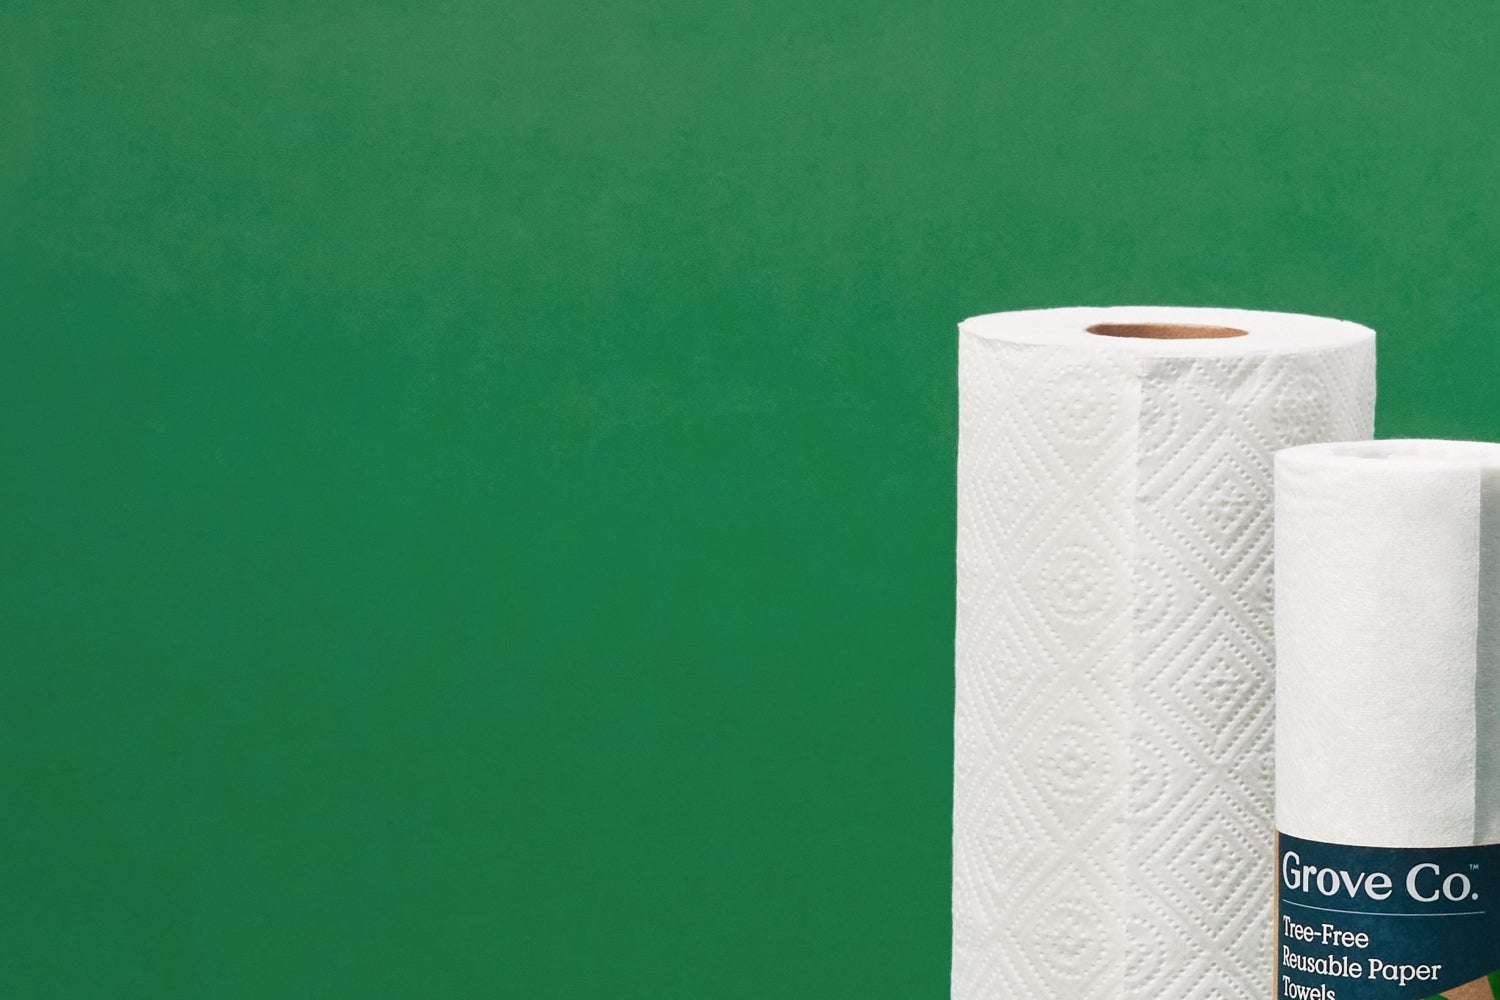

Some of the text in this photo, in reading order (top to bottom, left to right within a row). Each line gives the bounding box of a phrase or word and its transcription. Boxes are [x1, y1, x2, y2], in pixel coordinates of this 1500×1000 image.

[1283, 851, 1392, 900] Grove
[1283, 915, 1369, 948] Tree-Free
[1283, 945, 1442, 986] Reusable Paper
